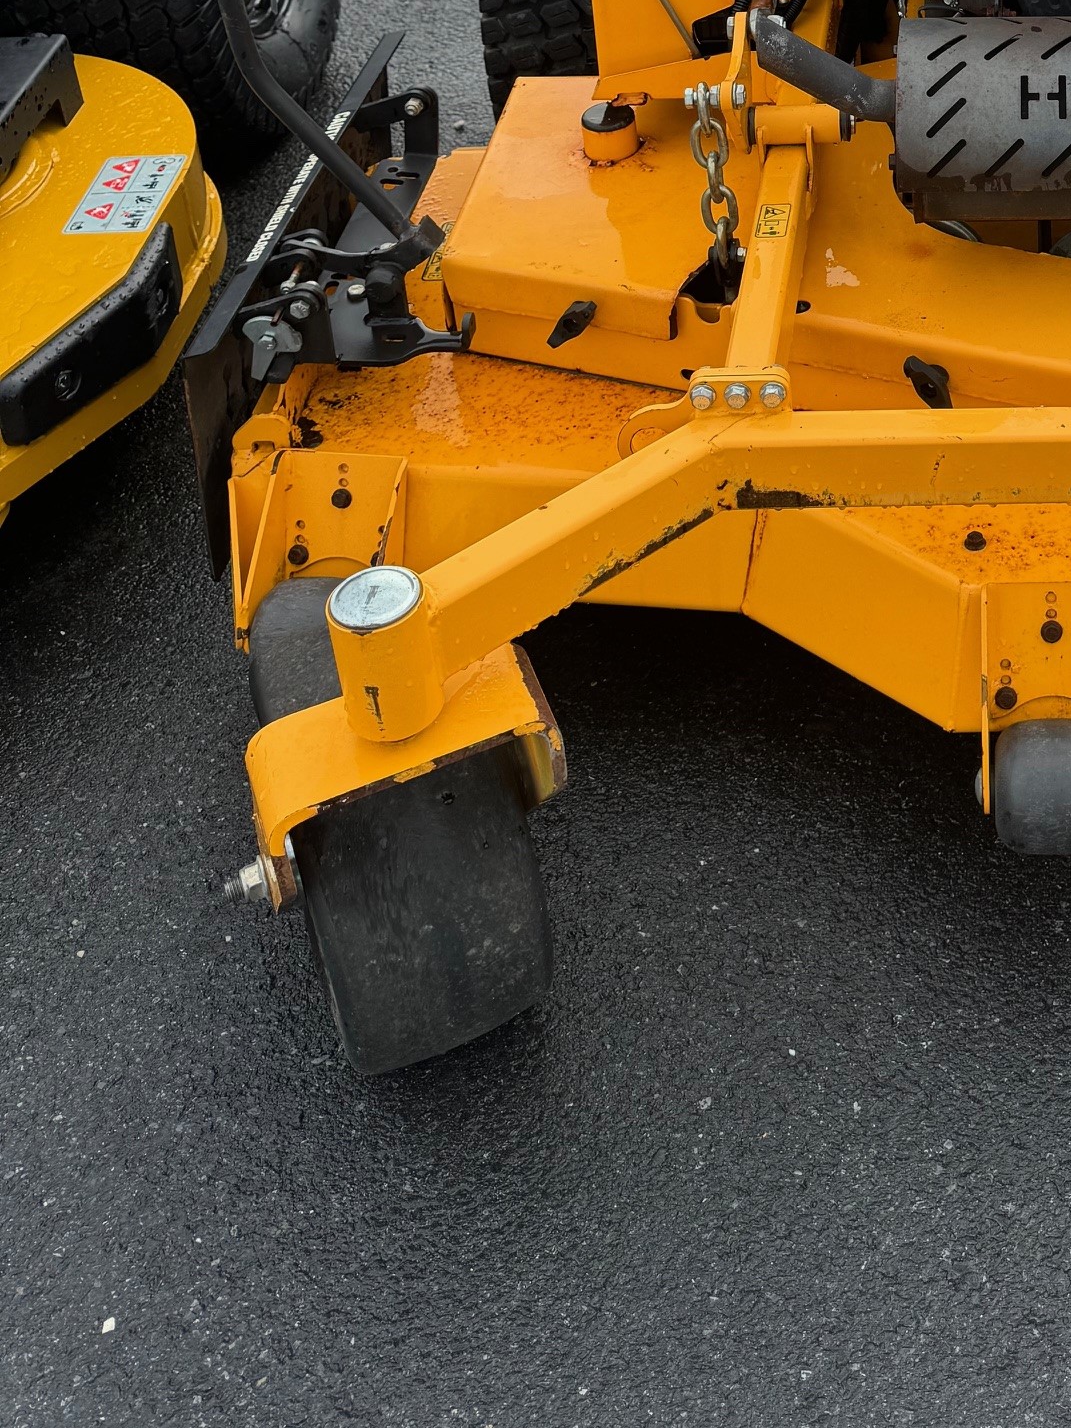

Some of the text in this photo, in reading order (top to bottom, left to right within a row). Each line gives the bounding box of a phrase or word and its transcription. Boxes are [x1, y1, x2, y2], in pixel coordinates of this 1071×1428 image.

[280, 184, 303, 204] WITH
[264, 204, 290, 231] SHIELD
[246, 232, 274, 262] CLOSED
